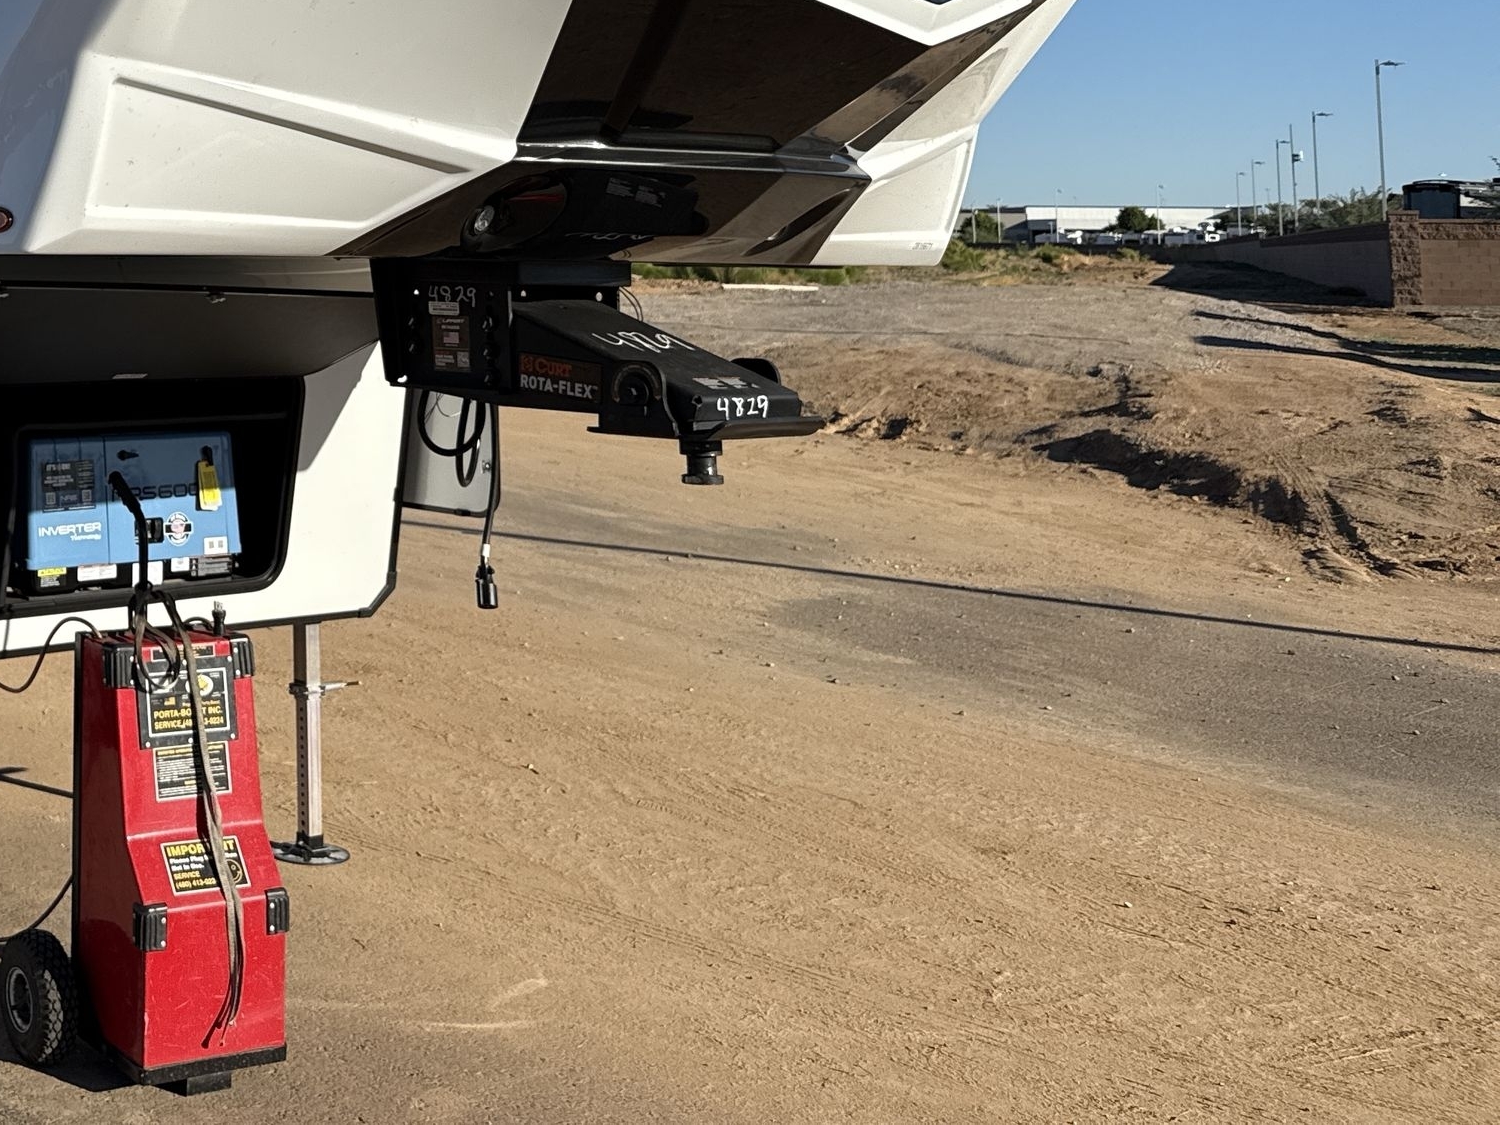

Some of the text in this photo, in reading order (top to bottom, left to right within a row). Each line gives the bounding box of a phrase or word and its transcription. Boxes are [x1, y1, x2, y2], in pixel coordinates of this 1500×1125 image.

[428, 285, 476, 307] 4829
[716, 394, 769, 420] 4829
[38, 521, 101, 537] INVERTER
[153, 706, 206, 719] PORTA-BOT
[166, 840, 234, 857] IMPORT
[192, 877, 216, 886] 413-022
